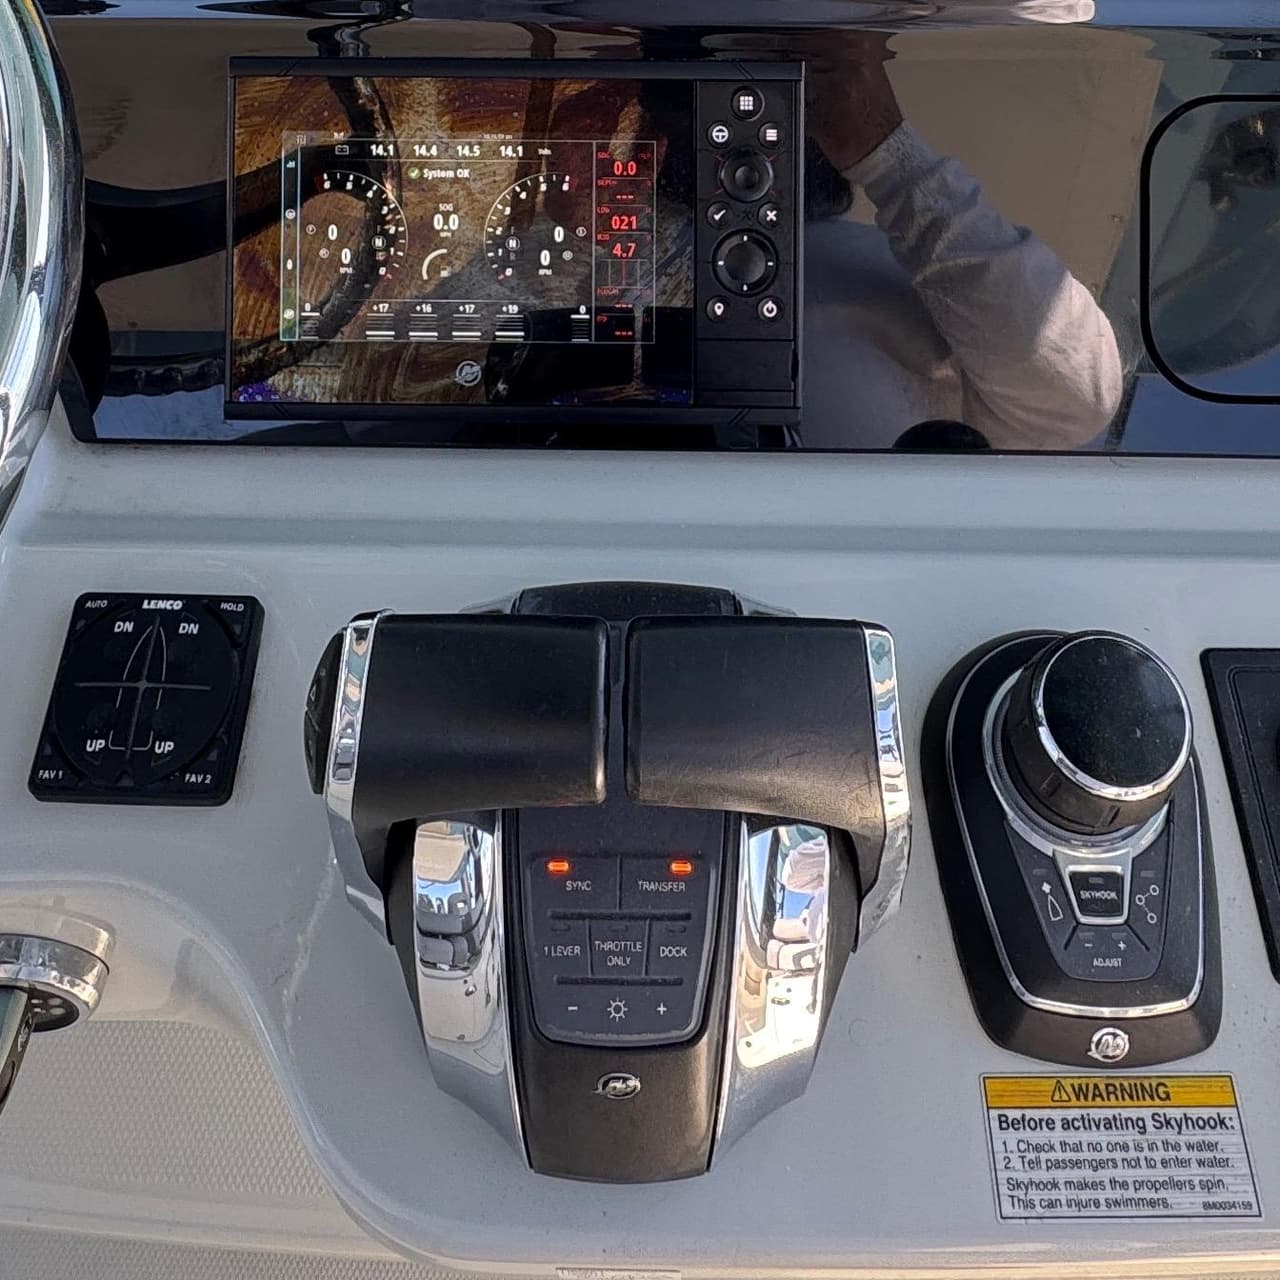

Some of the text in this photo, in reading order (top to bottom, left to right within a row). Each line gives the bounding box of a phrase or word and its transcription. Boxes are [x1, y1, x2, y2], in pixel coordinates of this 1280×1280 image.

[370, 144, 524, 157] 14.1 14.4 14.5 14.1
[423, 169, 470, 179] System OK
[613, 161, 637, 176] 0.0
[433, 214, 459, 231] 0.0
[611, 215, 638, 230] 021
[612, 242, 637, 258] 4.7
[85, 600, 108, 608] AUTO
[142, 599, 183, 610] LENCO
[220, 602, 245, 612] HOLD
[114, 621, 134, 633] DN
[178, 622, 199, 634] DN
[86, 739, 106, 752] UP
[154, 740, 175, 753] UP
[38, 770, 58, 779] FAV
[184, 774, 203, 783] FAV
[565, 880, 592, 891] SYNC
[638, 881, 686, 892] TRANSFER
[1080, 890, 1118, 900] SKYHOOK
[551, 946, 581, 957] LEVER
[594, 941, 643, 952] THROTTLE
[659, 946, 688, 958] DOCK
[607, 956, 631, 966] ONLY
[1093, 958, 1122, 967] ADJUST
[1072, 1083, 1171, 1102] WARNING
[998, 1112, 1235, 1135] Before activating Skyhook:
[1002, 1139, 1223, 1154] 1. Check that no one is in the water.
[1003, 1156, 1234, 1172] 2. Tell passengers not to enter water.
[1007, 1177, 1228, 1195] Skyhook makes the propellers spin.
[1009, 1195, 1172, 1212] This can injure swimmers.
